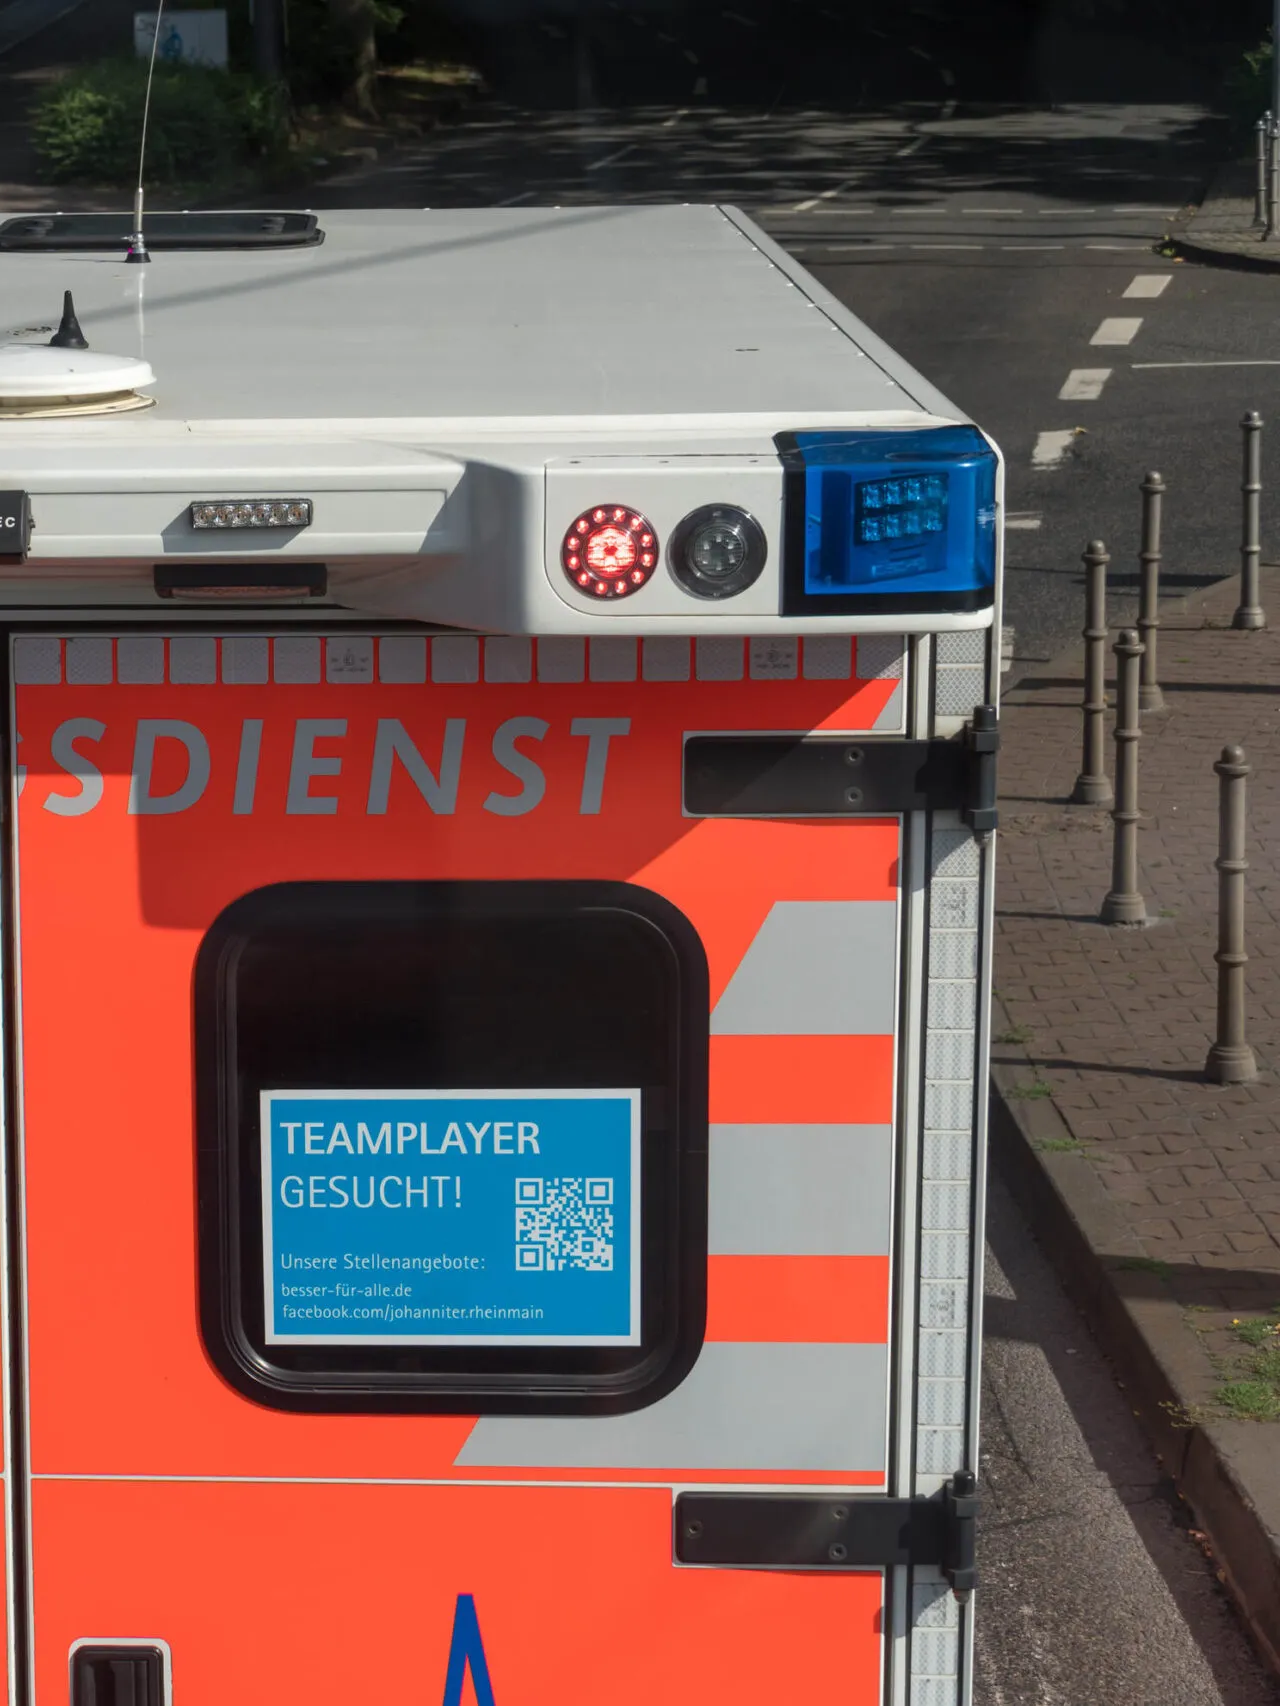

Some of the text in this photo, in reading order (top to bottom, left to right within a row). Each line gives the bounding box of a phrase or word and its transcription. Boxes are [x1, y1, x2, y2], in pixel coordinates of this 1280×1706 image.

[279, 1121, 540, 1155] TEAMPLAYER
[280, 1175, 462, 1209] GESUCHT!
[280, 1253, 486, 1274] Unsere Stellenangebote:
[281, 1283, 412, 1298] besser-für-alle.de
[282, 1304, 544, 1322] facebook.com/johanniter.rheinmain
